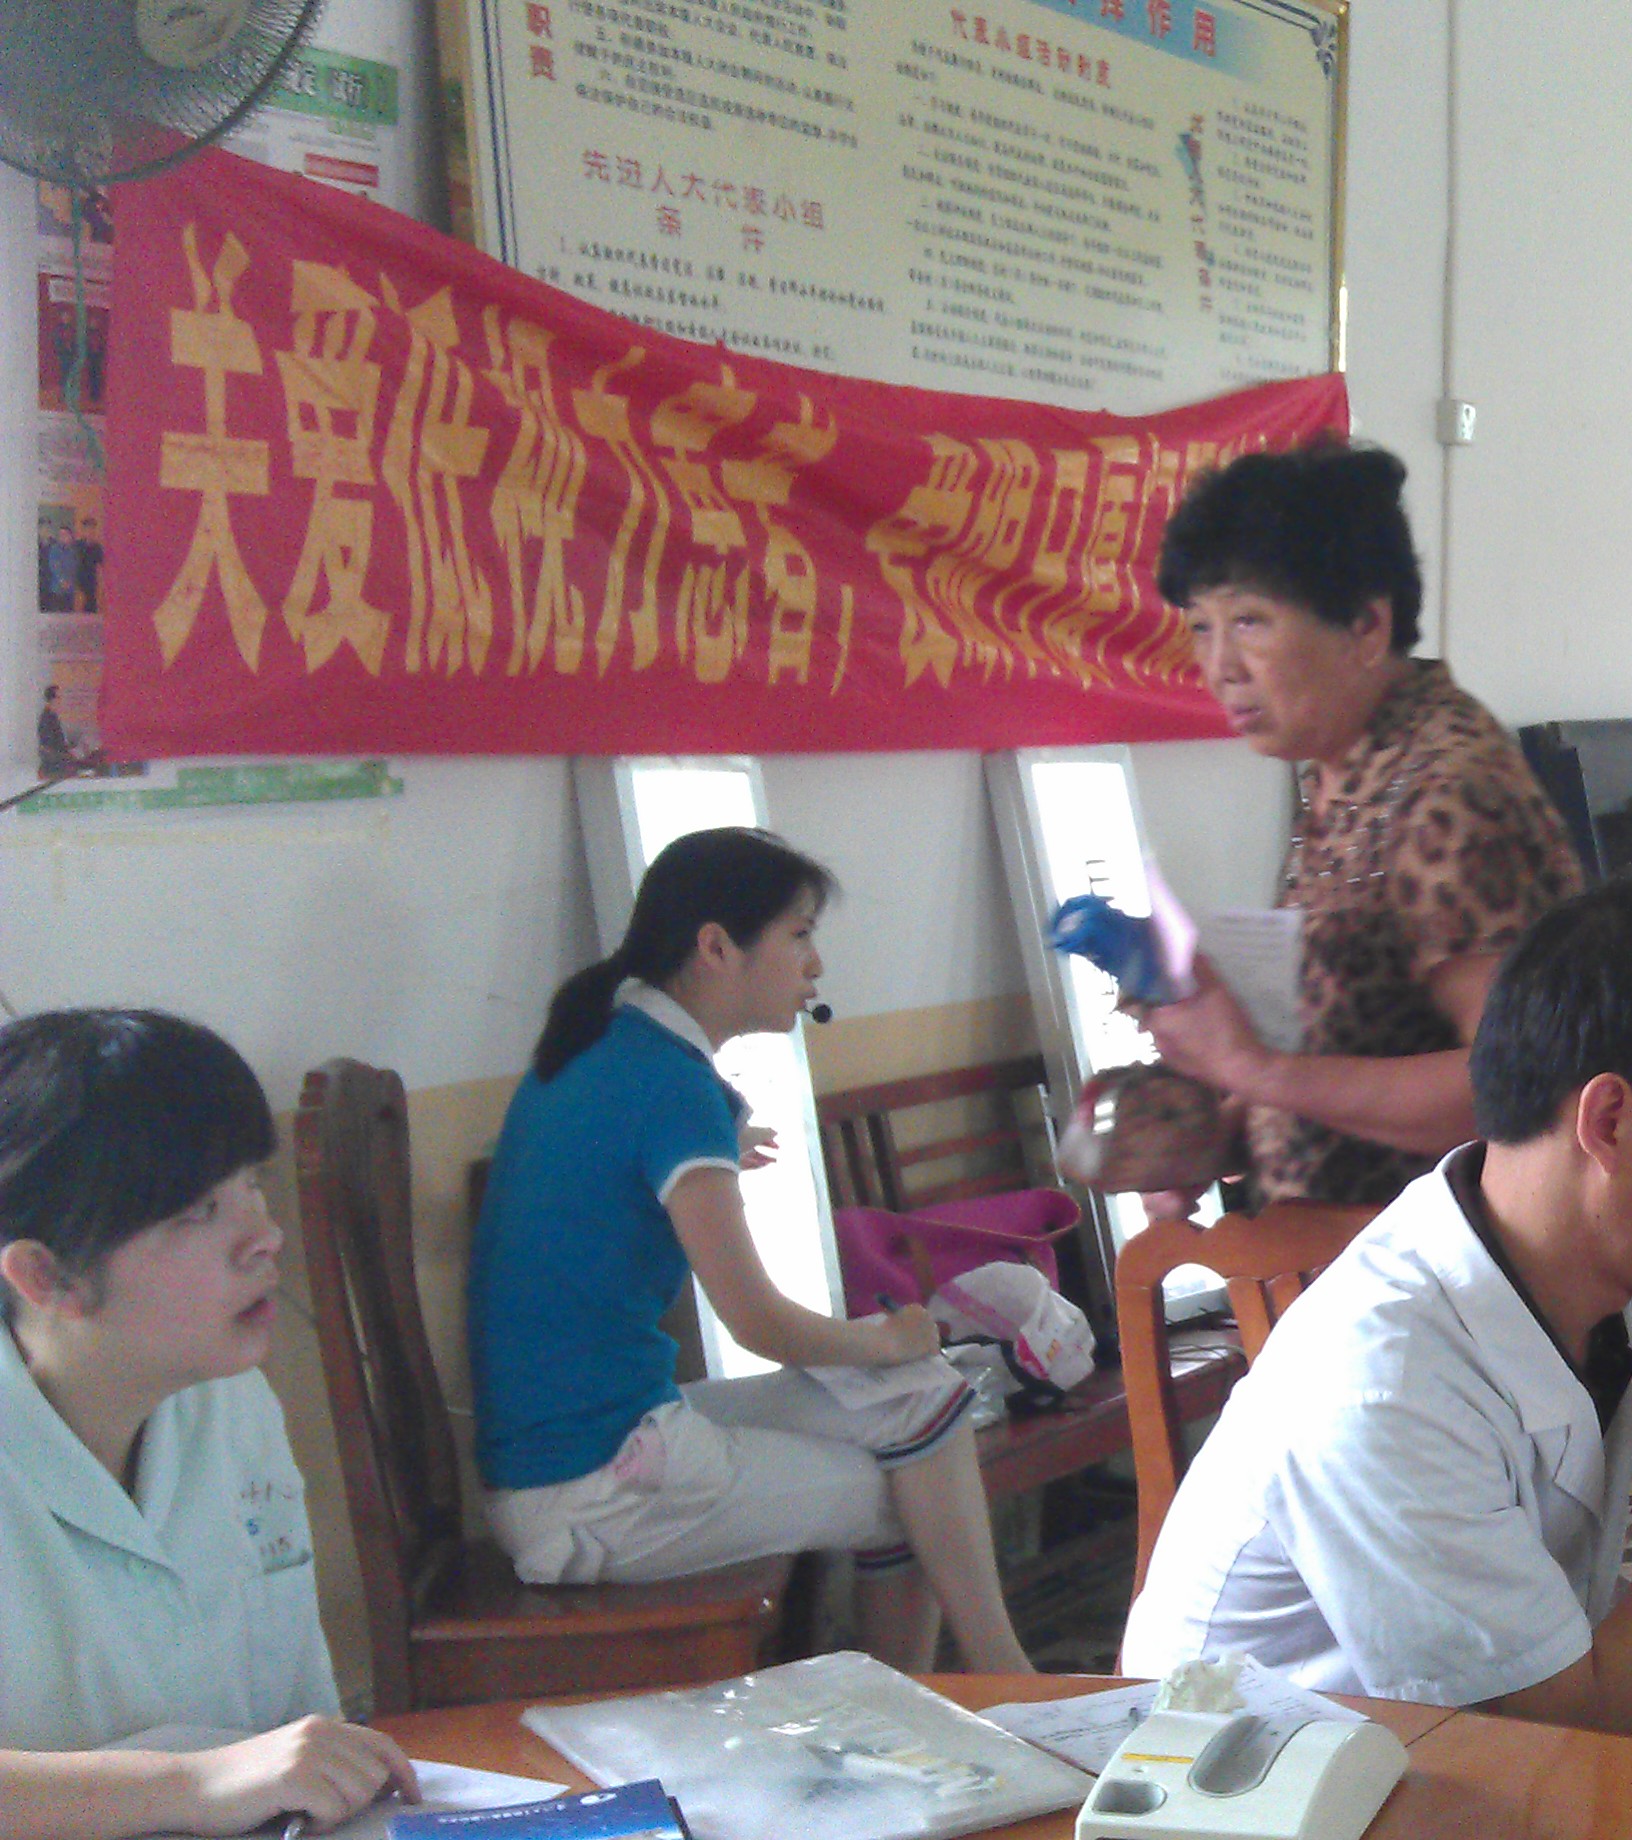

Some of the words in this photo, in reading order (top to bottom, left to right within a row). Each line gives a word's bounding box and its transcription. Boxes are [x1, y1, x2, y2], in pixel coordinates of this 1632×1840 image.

[582, 149, 824, 230] 先进人大代表小组
